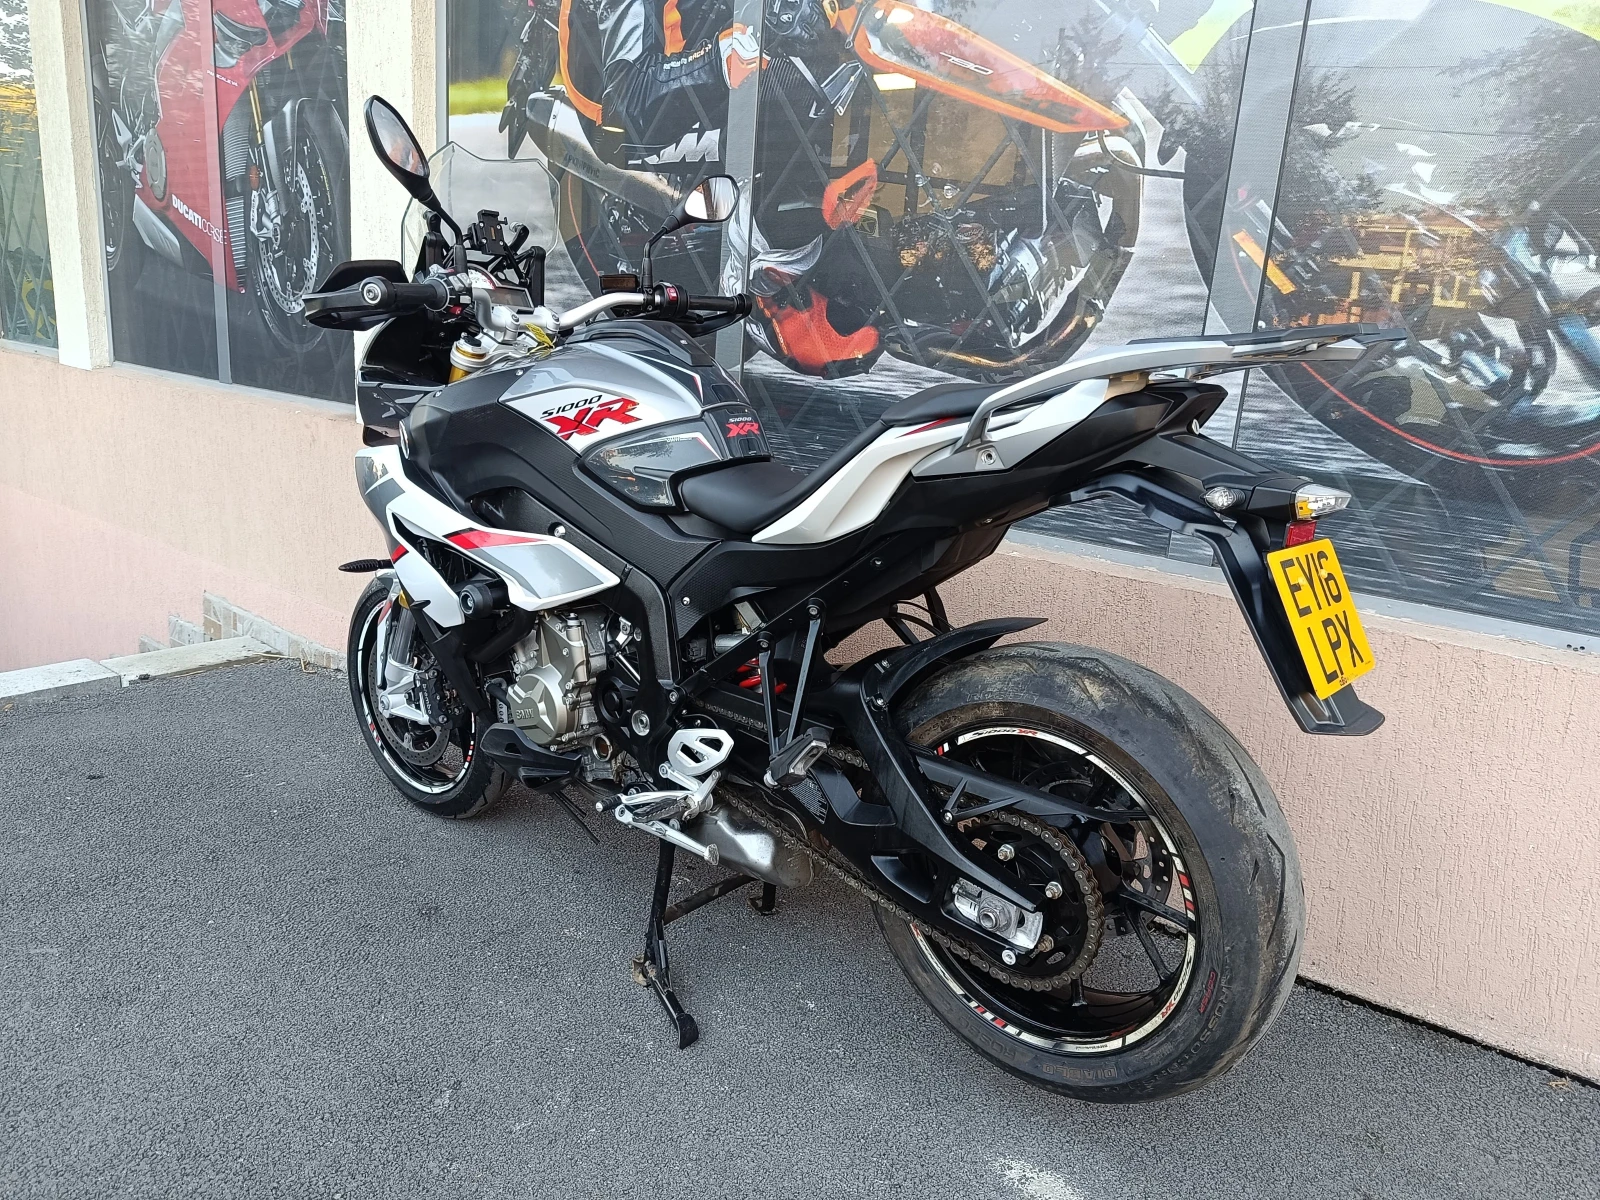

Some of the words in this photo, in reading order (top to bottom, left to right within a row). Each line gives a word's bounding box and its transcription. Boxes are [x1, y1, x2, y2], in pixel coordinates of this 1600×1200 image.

[540, 395, 602, 419] S1000
[544, 398, 643, 441] XR
[726, 422, 760, 437] XR
[1280, 551, 1342, 618] EY16
[1307, 610, 1364, 684] LPX
[1042, 1063, 1118, 1081] DIABLO
